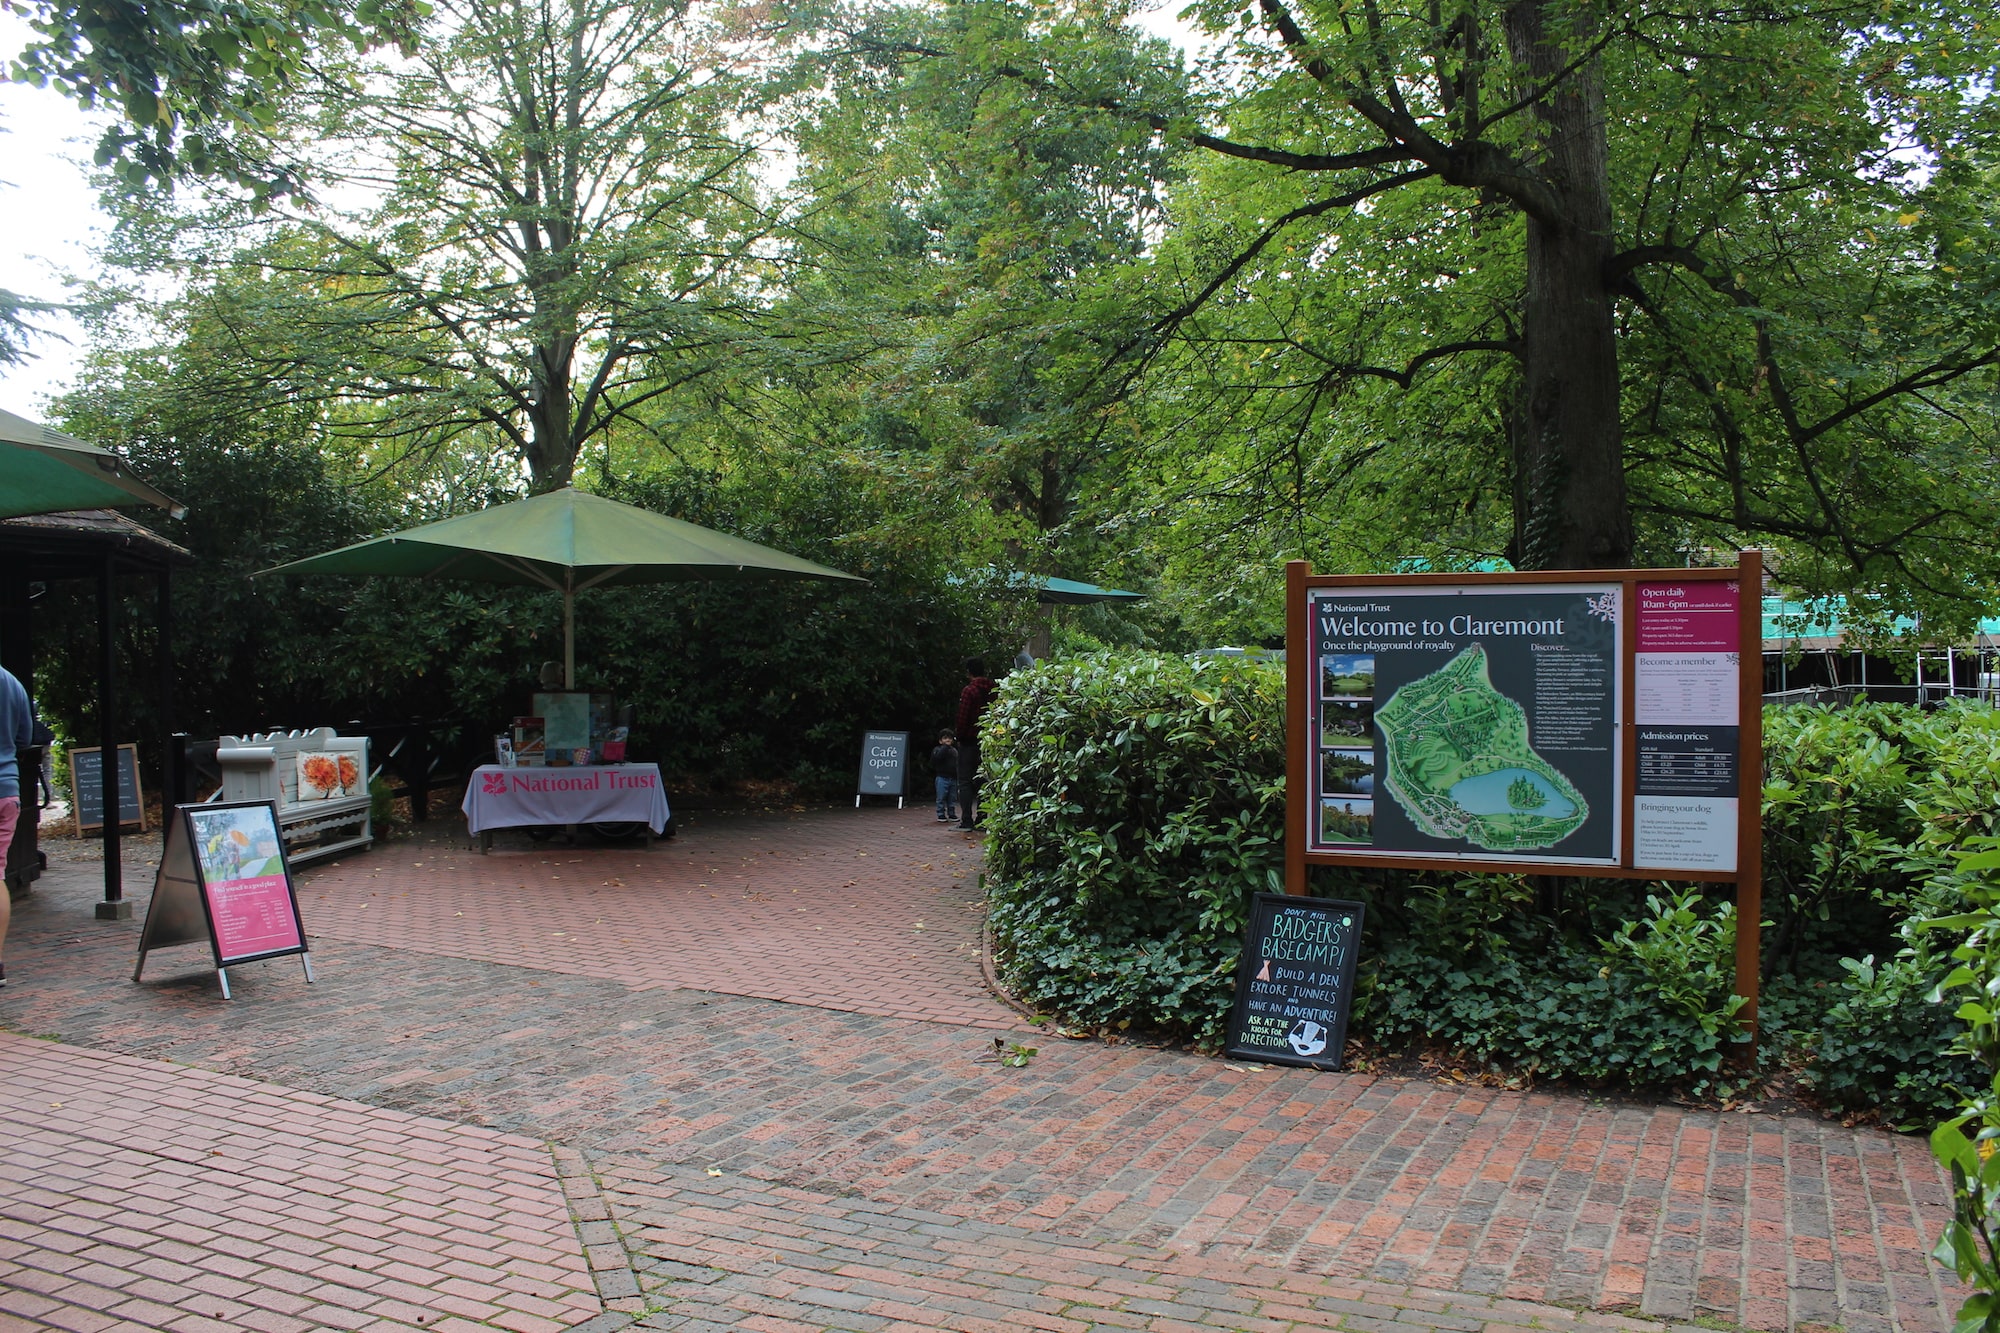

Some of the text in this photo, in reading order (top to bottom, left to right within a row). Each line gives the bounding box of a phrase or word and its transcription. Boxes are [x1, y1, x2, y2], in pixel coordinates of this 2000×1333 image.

[1642, 588, 1686, 598] Open daily
[1333, 603, 1390, 612] National Trust
[1321, 615, 1565, 636] Welcome to Claremont
[1323, 640, 1455, 651] Once the playground of royalty
[1640, 658, 1673, 666] Become
[1681, 657, 1716, 665] member
[1640, 732, 1709, 742] Admission prices
[871, 746, 897, 757] Café
[869, 758, 898, 769] open
[512, 771, 656, 793] National Trust
[1641, 803, 1711, 814] Bringing your dog
[225, 884, 243, 893] yourself
[1310, 911, 1326, 920] MISS
[1272, 914, 1341, 944] BADGERS
[1275, 966, 1305, 981] BUILD
[1308, 972, 1315, 984] A
[1250, 981, 1336, 1004] EXPLORE TUNNELS
[1248, 1000, 1337, 1024] HAVE AN ADVENTURE!
[1248, 1015, 1288, 1029] ASK AT THE
[1250, 1025, 1283, 1037] KIOSK FOR
[1240, 1031, 1288, 1048] DIRECTIONS
